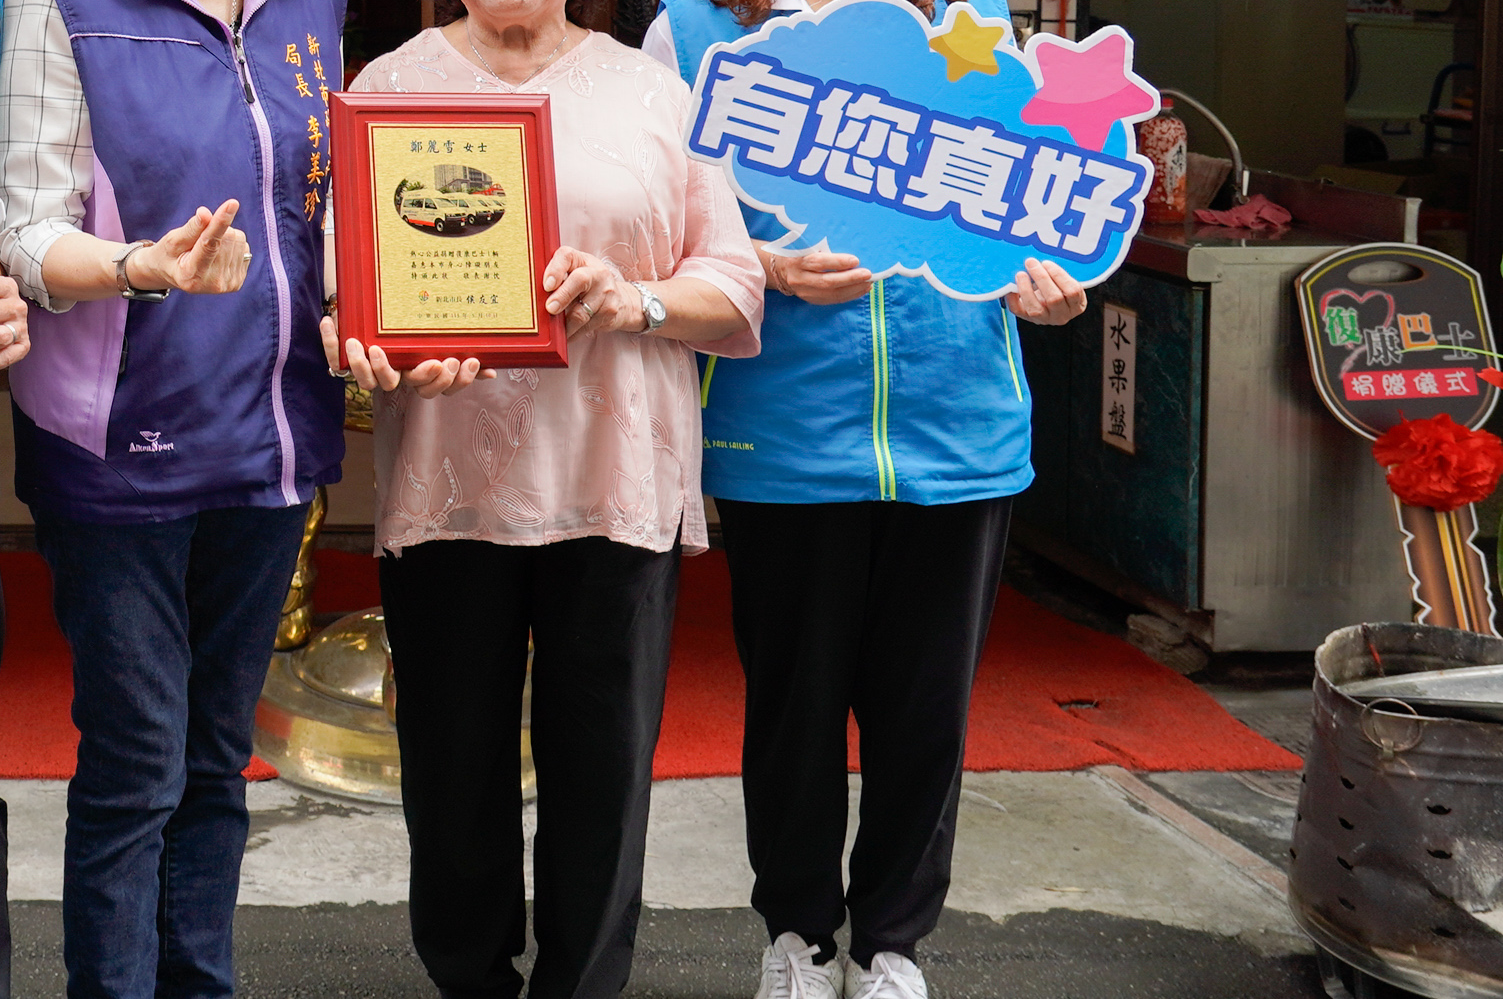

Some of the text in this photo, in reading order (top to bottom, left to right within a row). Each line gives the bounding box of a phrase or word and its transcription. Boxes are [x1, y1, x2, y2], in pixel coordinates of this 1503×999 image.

[285, 44, 325, 222] 局長 李美珍
[697, 59, 1138, 257] 有您真好
[1108, 312, 1133, 440] 水果盤
[1324, 306, 1478, 367] 復康巴士
[1350, 371, 1471, 397] 捐贈儀式
